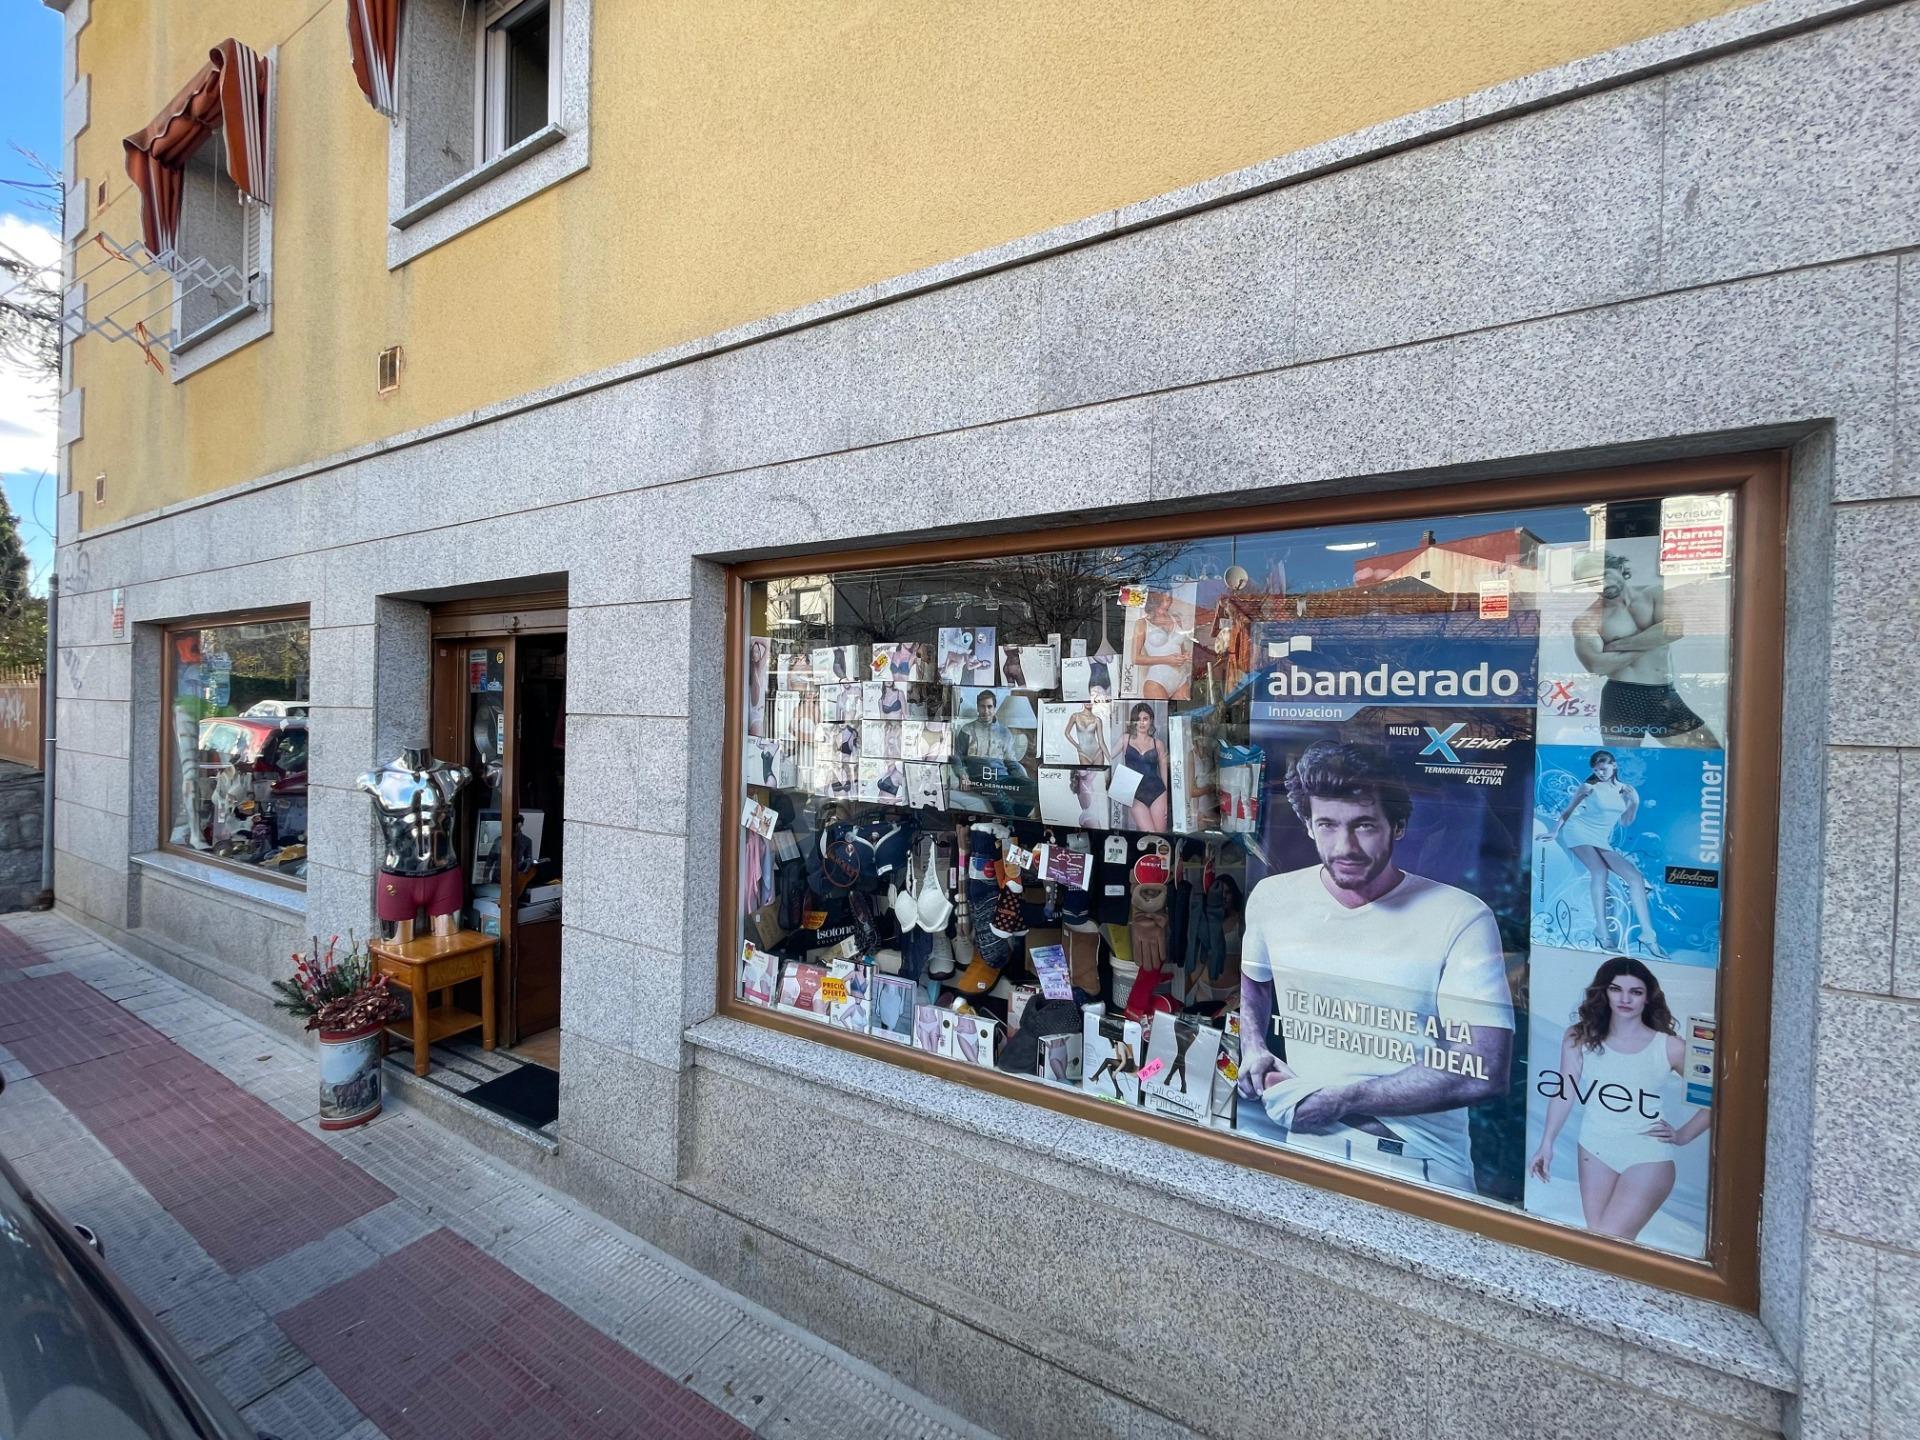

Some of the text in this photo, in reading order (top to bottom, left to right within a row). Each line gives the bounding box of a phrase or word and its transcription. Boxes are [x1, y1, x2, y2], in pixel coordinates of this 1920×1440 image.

[1665, 509, 1722, 519] verisure
[1665, 529, 1722, 540] Alarma
[1268, 662, 1519, 697] abanderado
[1268, 705, 1343, 718] Innovacion
[1389, 726, 1419, 736] NUEVO
[1610, 724, 1668, 736] algodon
[1424, 766, 1505, 777] TERMORREGULACIÓN
[1466, 775, 1503, 786] ACTIVA
[1700, 760, 1722, 864] summer
[1668, 868, 1716, 882] filodoro
[823, 981, 846, 990] PRECIO
[823, 988, 848, 998] OFERTA
[1286, 989, 1472, 1046] TE MANTIENE A LA
[1271, 1014, 1490, 1081] TEMPERATURA IDEAL
[1146, 1081, 1203, 1110] Full Colour
[1537, 1069, 1661, 1120] avet
